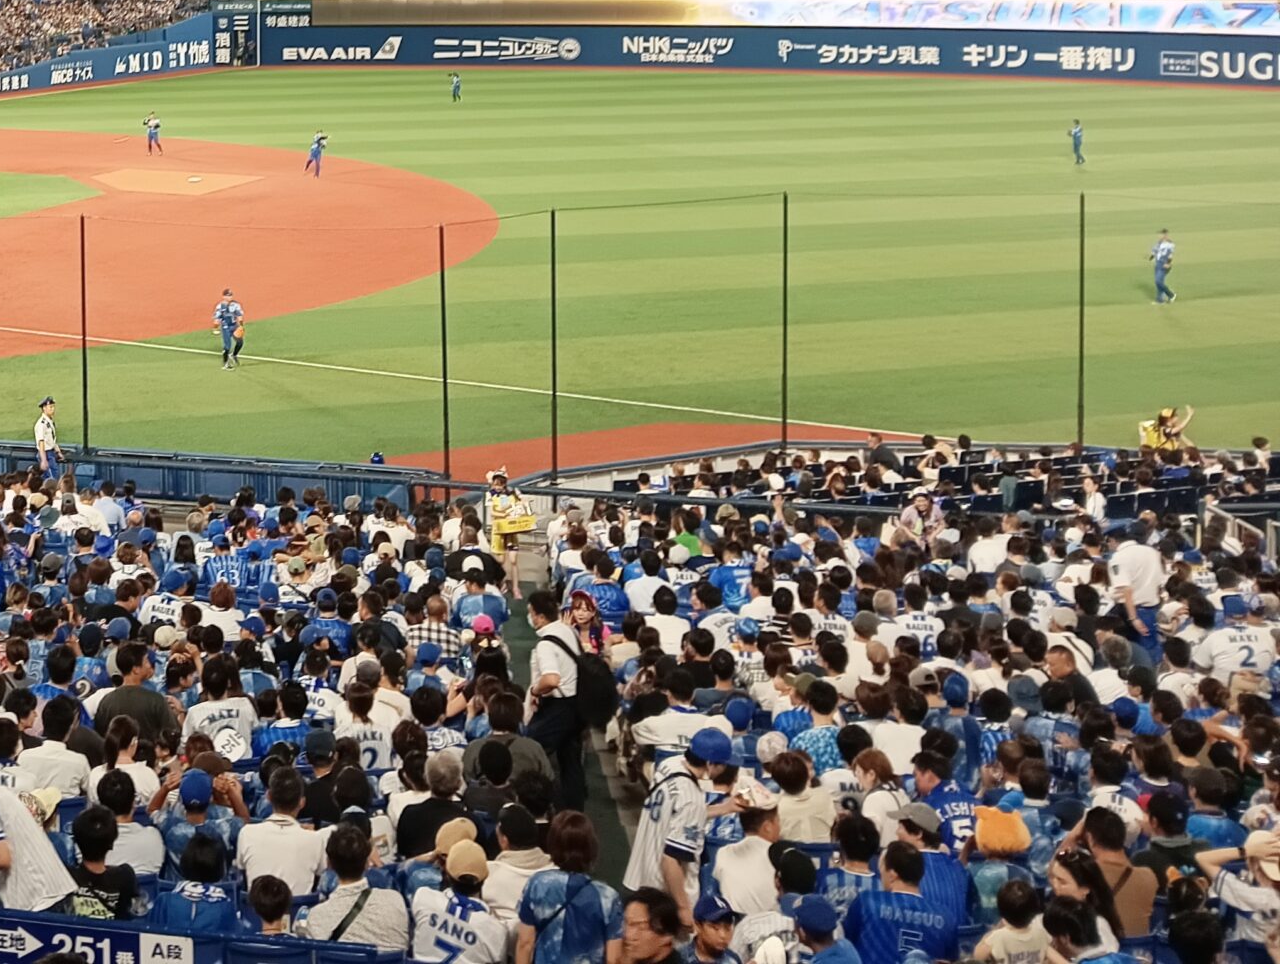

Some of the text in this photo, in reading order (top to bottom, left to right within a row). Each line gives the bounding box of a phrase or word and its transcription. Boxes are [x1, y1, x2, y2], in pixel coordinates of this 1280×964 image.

[818, 45, 940, 66] タカナシ乳業
[1200, 50, 1280, 81] SUG
[217, 569, 241, 588] 63
[1228, 634, 1259, 644] MAKI
[1238, 645, 1258, 668] 2
[880, 903, 945, 930] MATSUO
[428, 913, 478, 947] SANO
[151, 942, 184, 962] A段
[434, 935, 466, 964] 7
